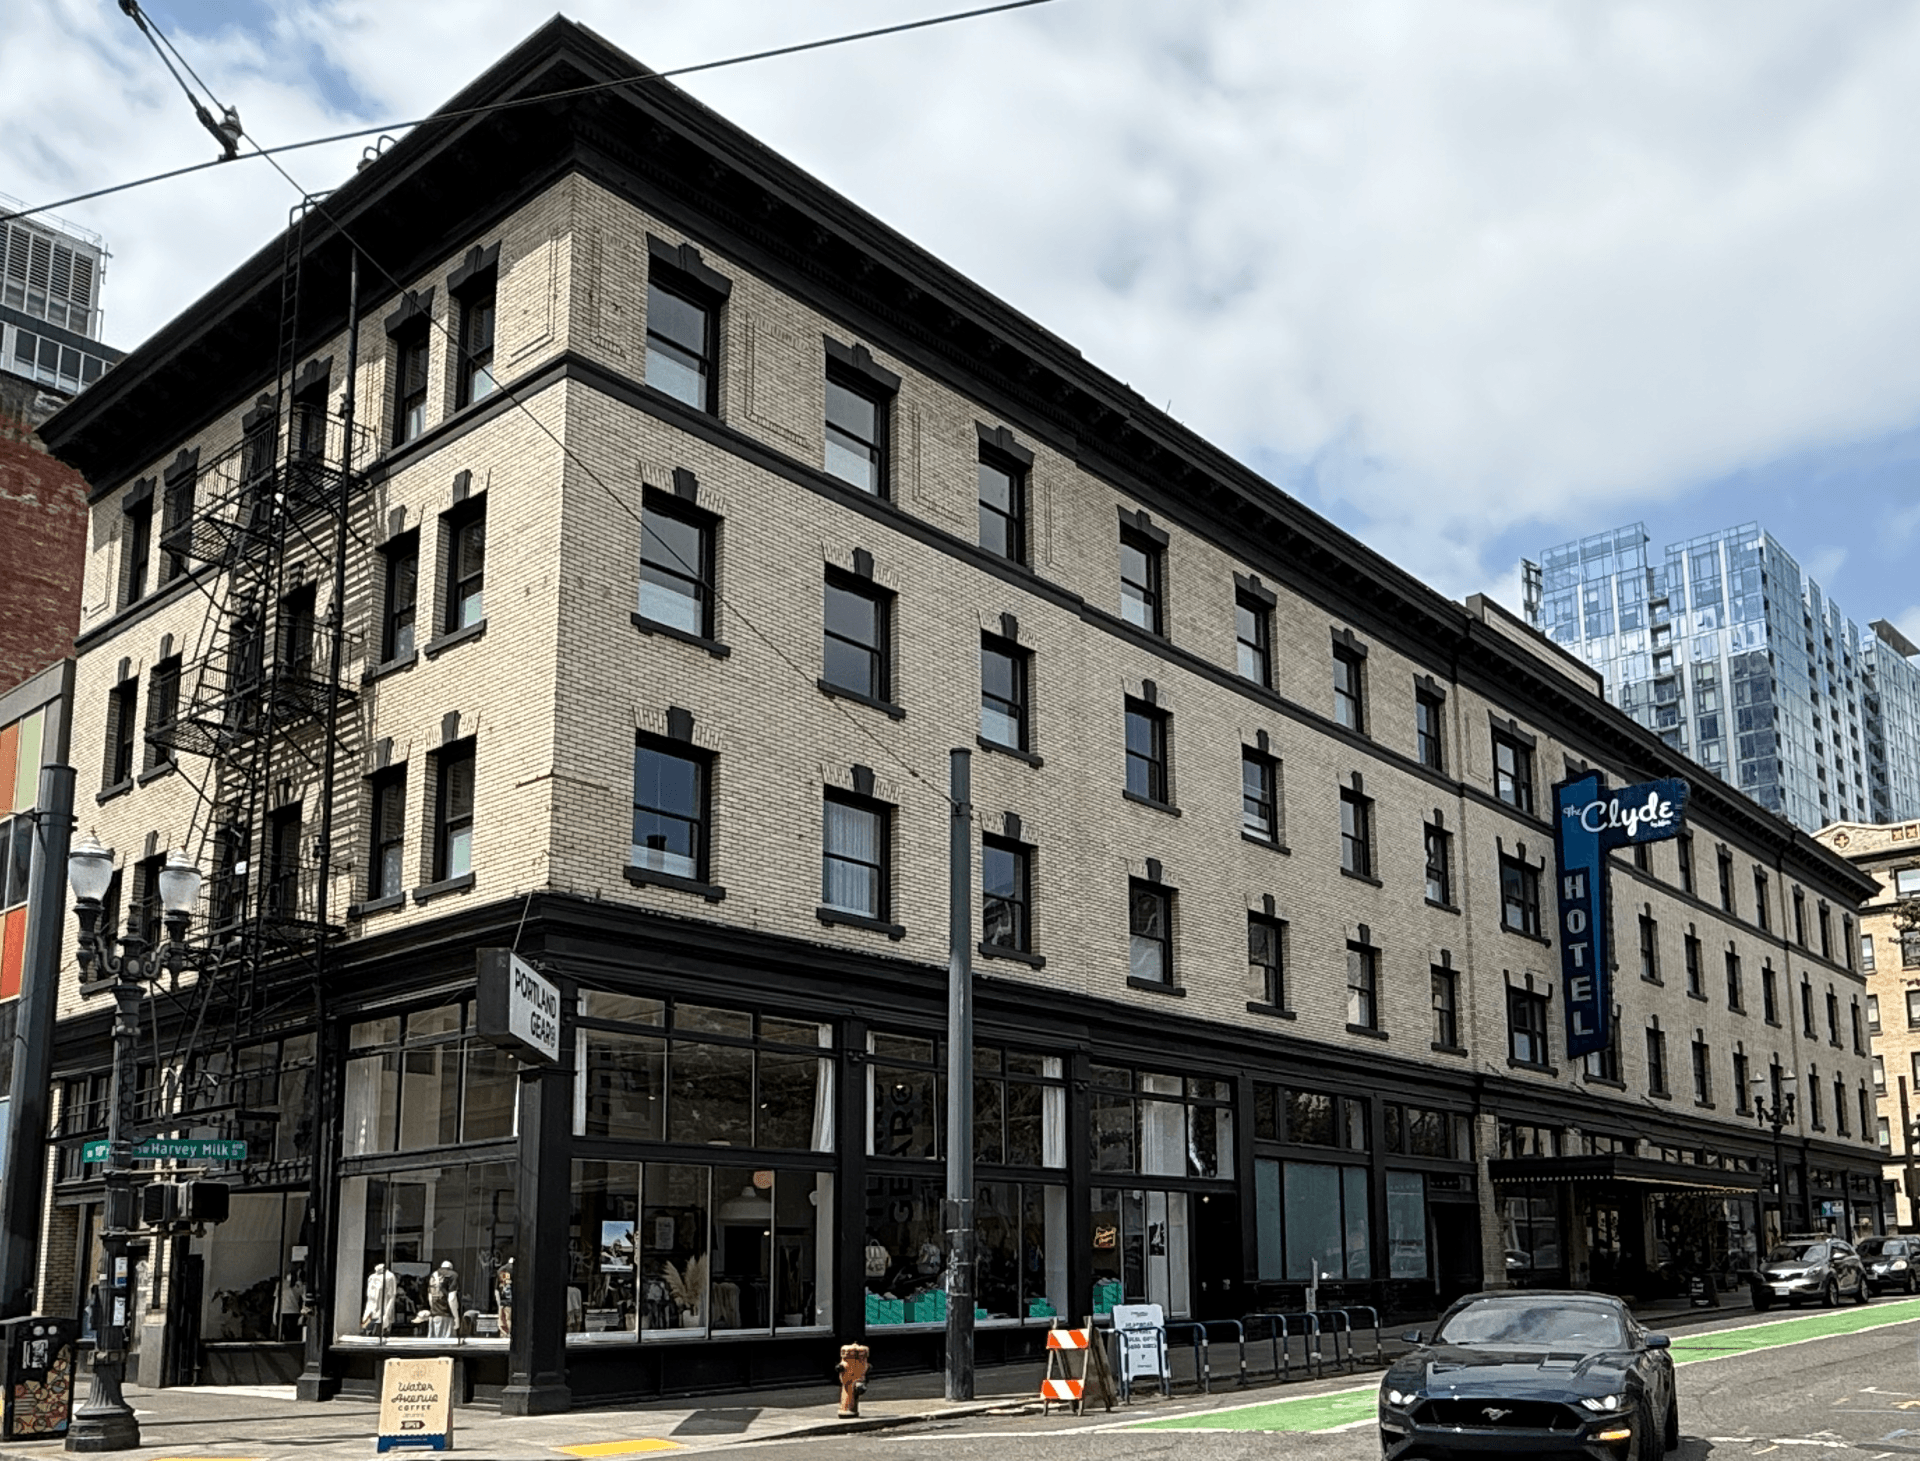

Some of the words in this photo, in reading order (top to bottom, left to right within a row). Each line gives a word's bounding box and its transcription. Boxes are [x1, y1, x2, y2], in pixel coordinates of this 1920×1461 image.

[1580, 791, 1675, 837] Clyde
[1564, 873, 1594, 1036] HOTEL
[515, 966, 557, 1020] PORTLAND
[151, 1143, 198, 1158] Harvey
[202, 1143, 229, 1156] Milk
[397, 1381, 435, 1392] Water
[391, 1393, 439, 1404] Avenue
[397, 1404, 432, 1412] COFFEE
